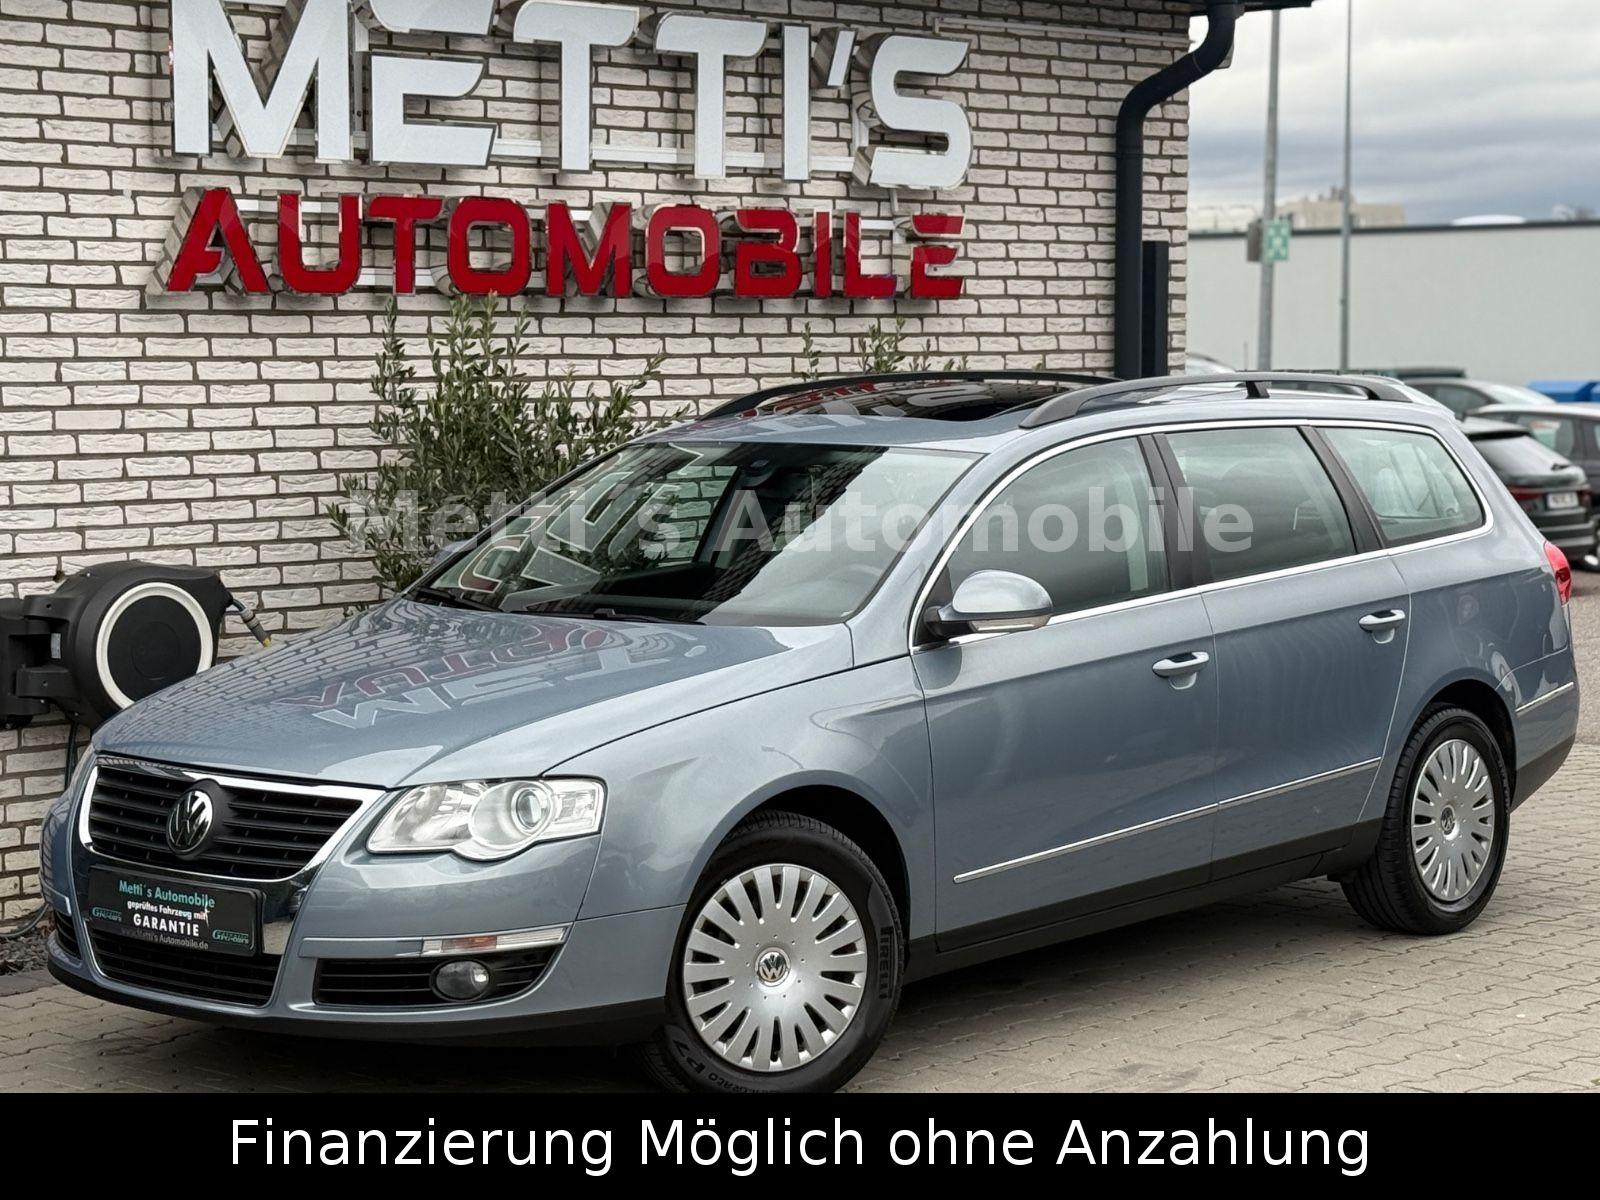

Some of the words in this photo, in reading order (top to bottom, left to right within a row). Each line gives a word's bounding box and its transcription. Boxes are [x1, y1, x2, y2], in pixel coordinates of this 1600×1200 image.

[170, 0, 974, 190] METTI'S
[167, 187, 965, 298] AUTOMOBILE
[127, 900, 158, 914] geprüftes
[159, 904, 192, 920] Fahrzeug
[193, 911, 208, 921] mit
[154, 887, 216, 909] Automobile
[133, 913, 200, 937] GARANTIE
[878, 926, 896, 1000] PIRELLI
